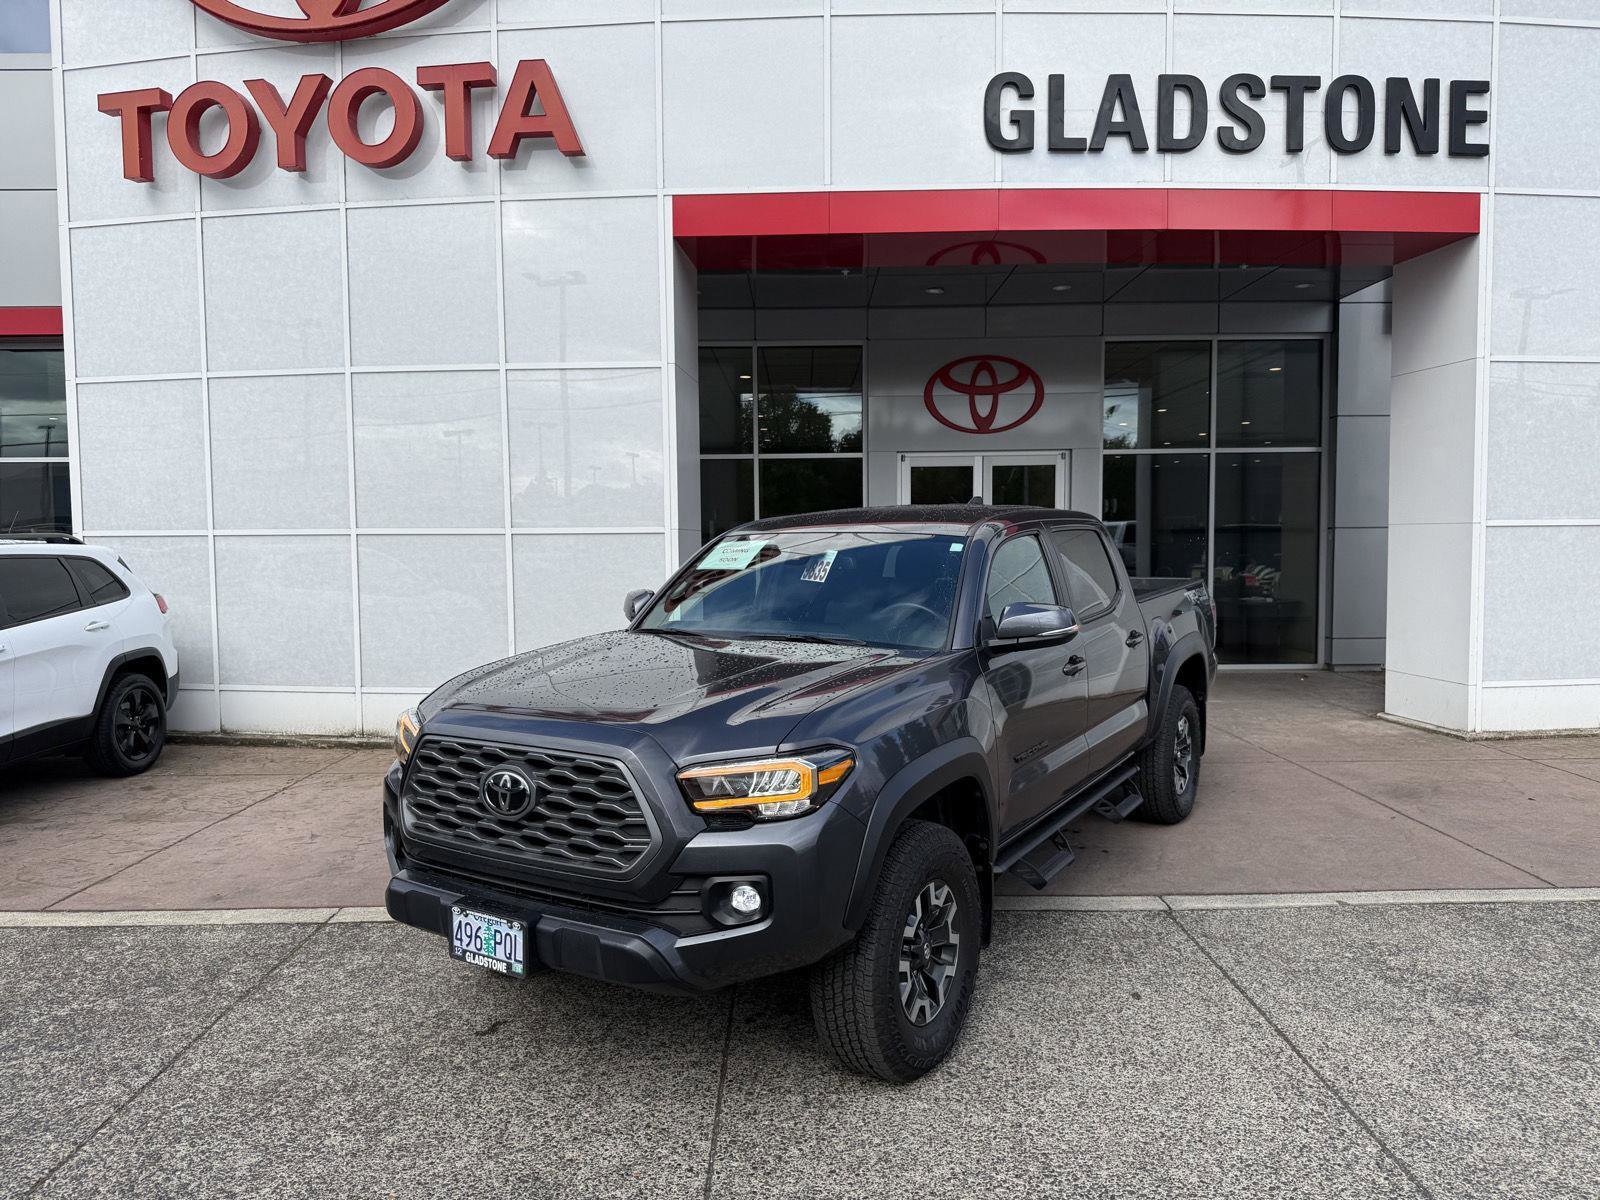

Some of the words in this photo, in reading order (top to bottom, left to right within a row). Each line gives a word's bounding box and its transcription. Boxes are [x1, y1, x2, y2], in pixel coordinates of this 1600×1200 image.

[98, 58, 586, 183] TOYOTA
[984, 72, 1491, 157] GLADSTONE
[455, 920, 483, 952] 496
[494, 929, 523, 963] PQL
[465, 952, 507, 973] GLADSTONE
